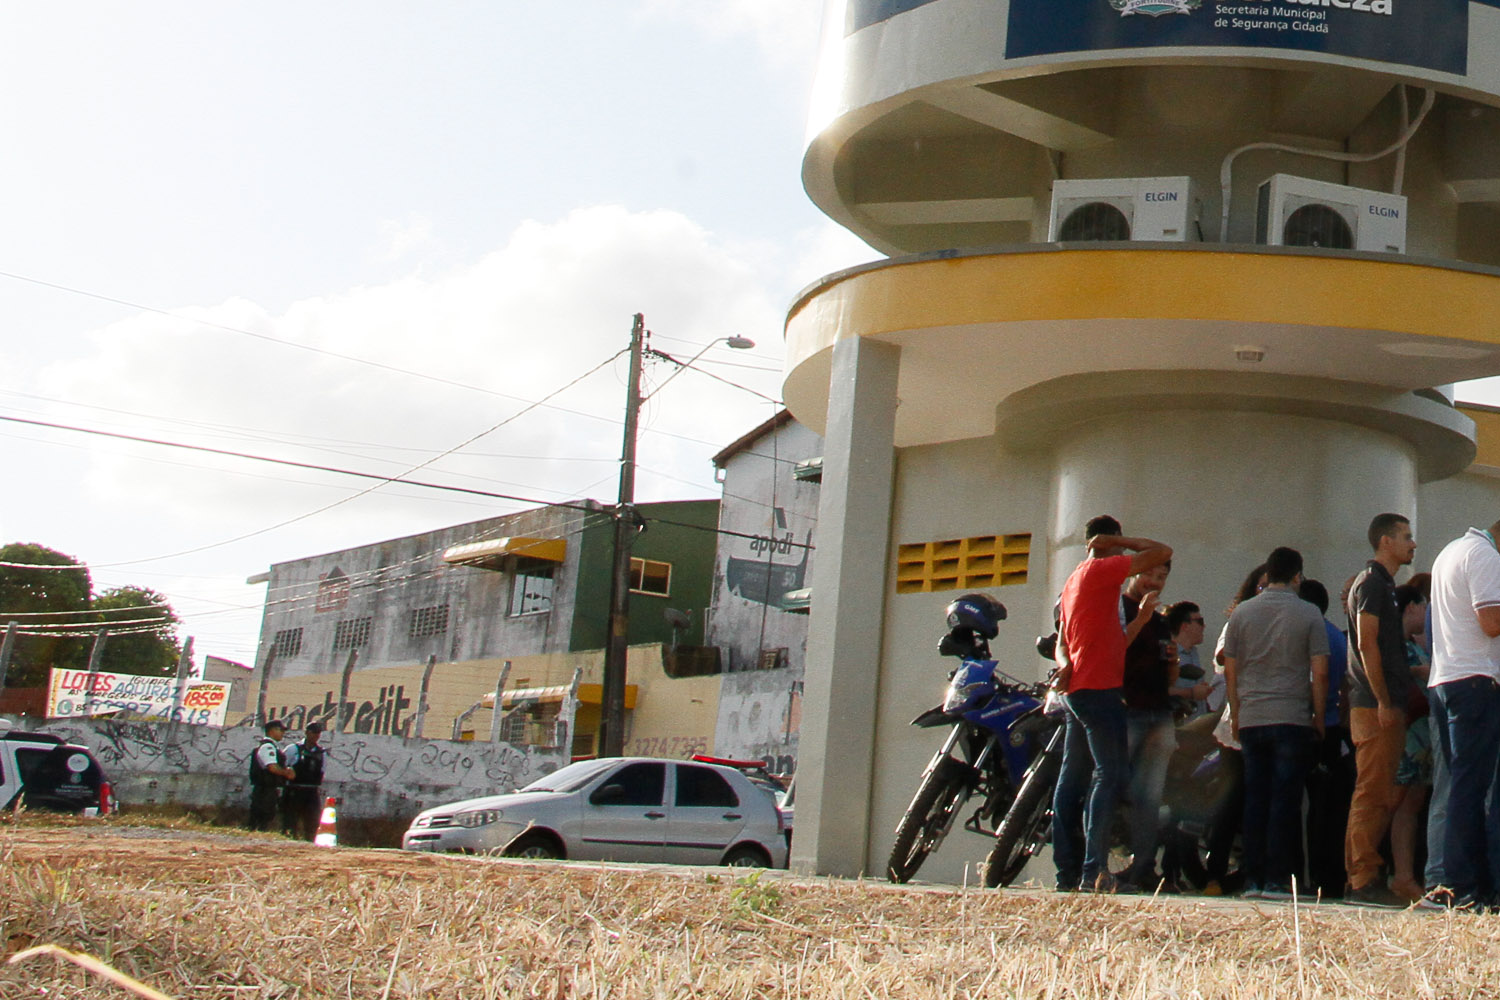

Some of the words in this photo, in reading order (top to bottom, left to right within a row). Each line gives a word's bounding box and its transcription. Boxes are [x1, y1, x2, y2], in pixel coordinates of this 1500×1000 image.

[1215, 4, 1269, 16] Secretaria
[1272, 6, 1326, 20] Municipal
[1214, 17, 1228, 28] de
[1232, 18, 1288, 31] Segurança
[1292, 21, 1328, 34] Cidadã
[1145, 192, 1178, 202] ELGIN
[1368, 205, 1399, 219] ELGIN
[750, 532, 794, 557] apodi
[62, 671, 116, 691] LOTES
[114, 682, 183, 699] AQUIRAZ
